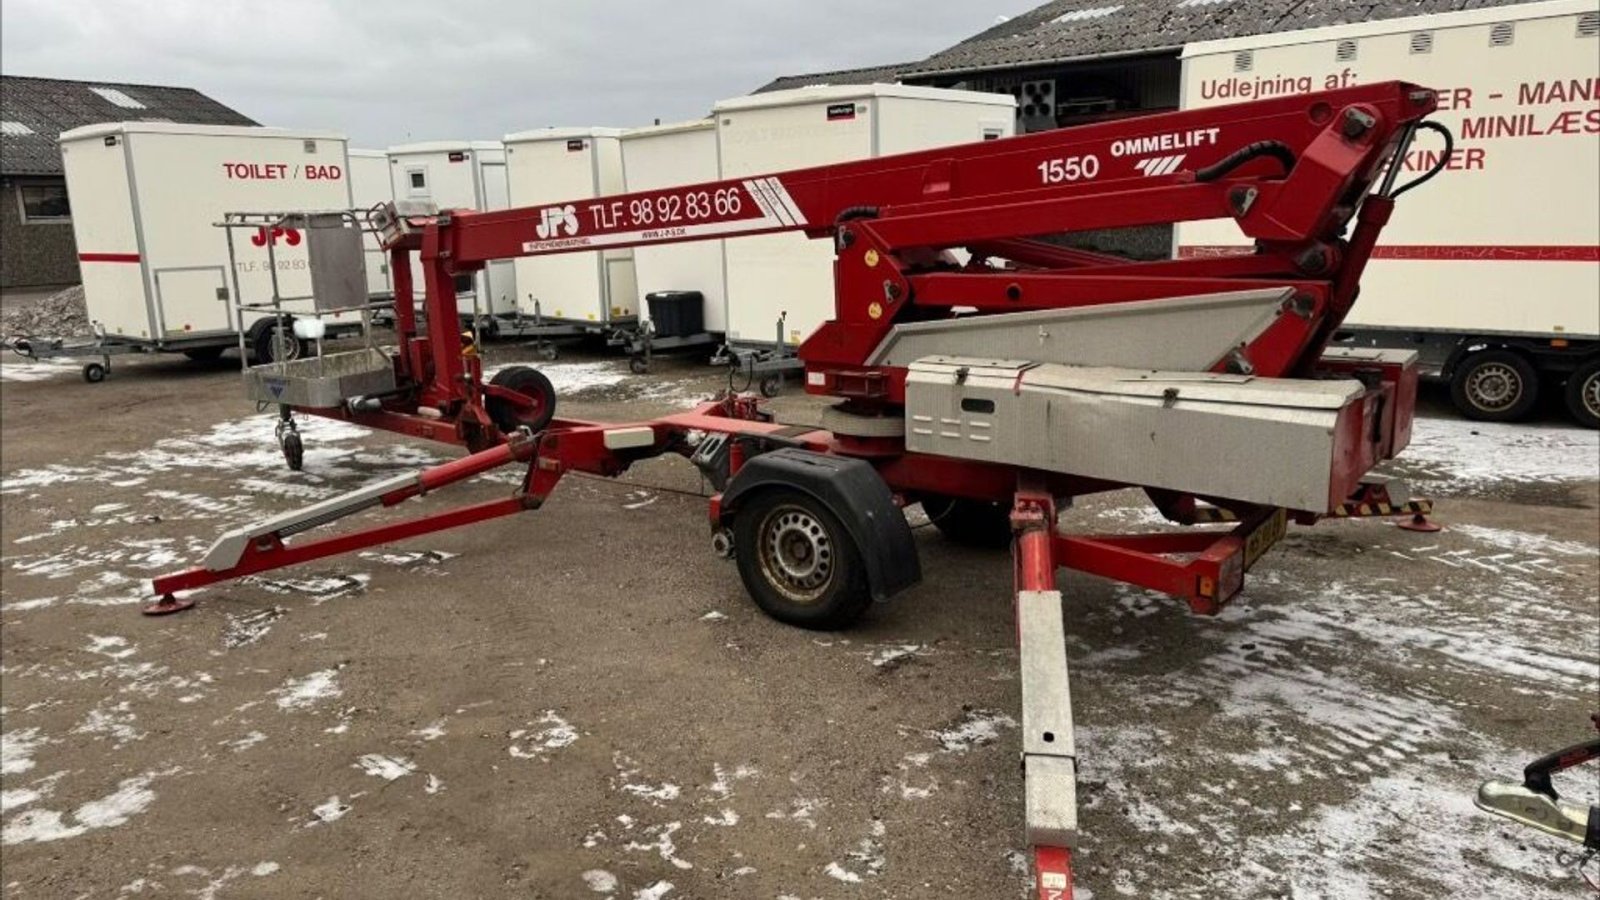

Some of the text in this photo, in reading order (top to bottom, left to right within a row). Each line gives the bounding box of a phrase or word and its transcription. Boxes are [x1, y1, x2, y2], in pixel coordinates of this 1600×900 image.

[1201, 70, 1357, 99] Udlejning af:
[1111, 128, 1220, 156] OMMELIFT
[224, 164, 287, 179] TOILET
[305, 165, 341, 179] BAD
[1038, 155, 1099, 183] 1550
[1384, 149, 1485, 172] KINER
[536, 204, 579, 239] JPS
[589, 202, 627, 229] TLF.
[630, 199, 654, 225] 98
[657, 195, 683, 222] 92
[686, 192, 711, 219] 83
[715, 187, 741, 215] 66
[251, 226, 301, 246] JPS
